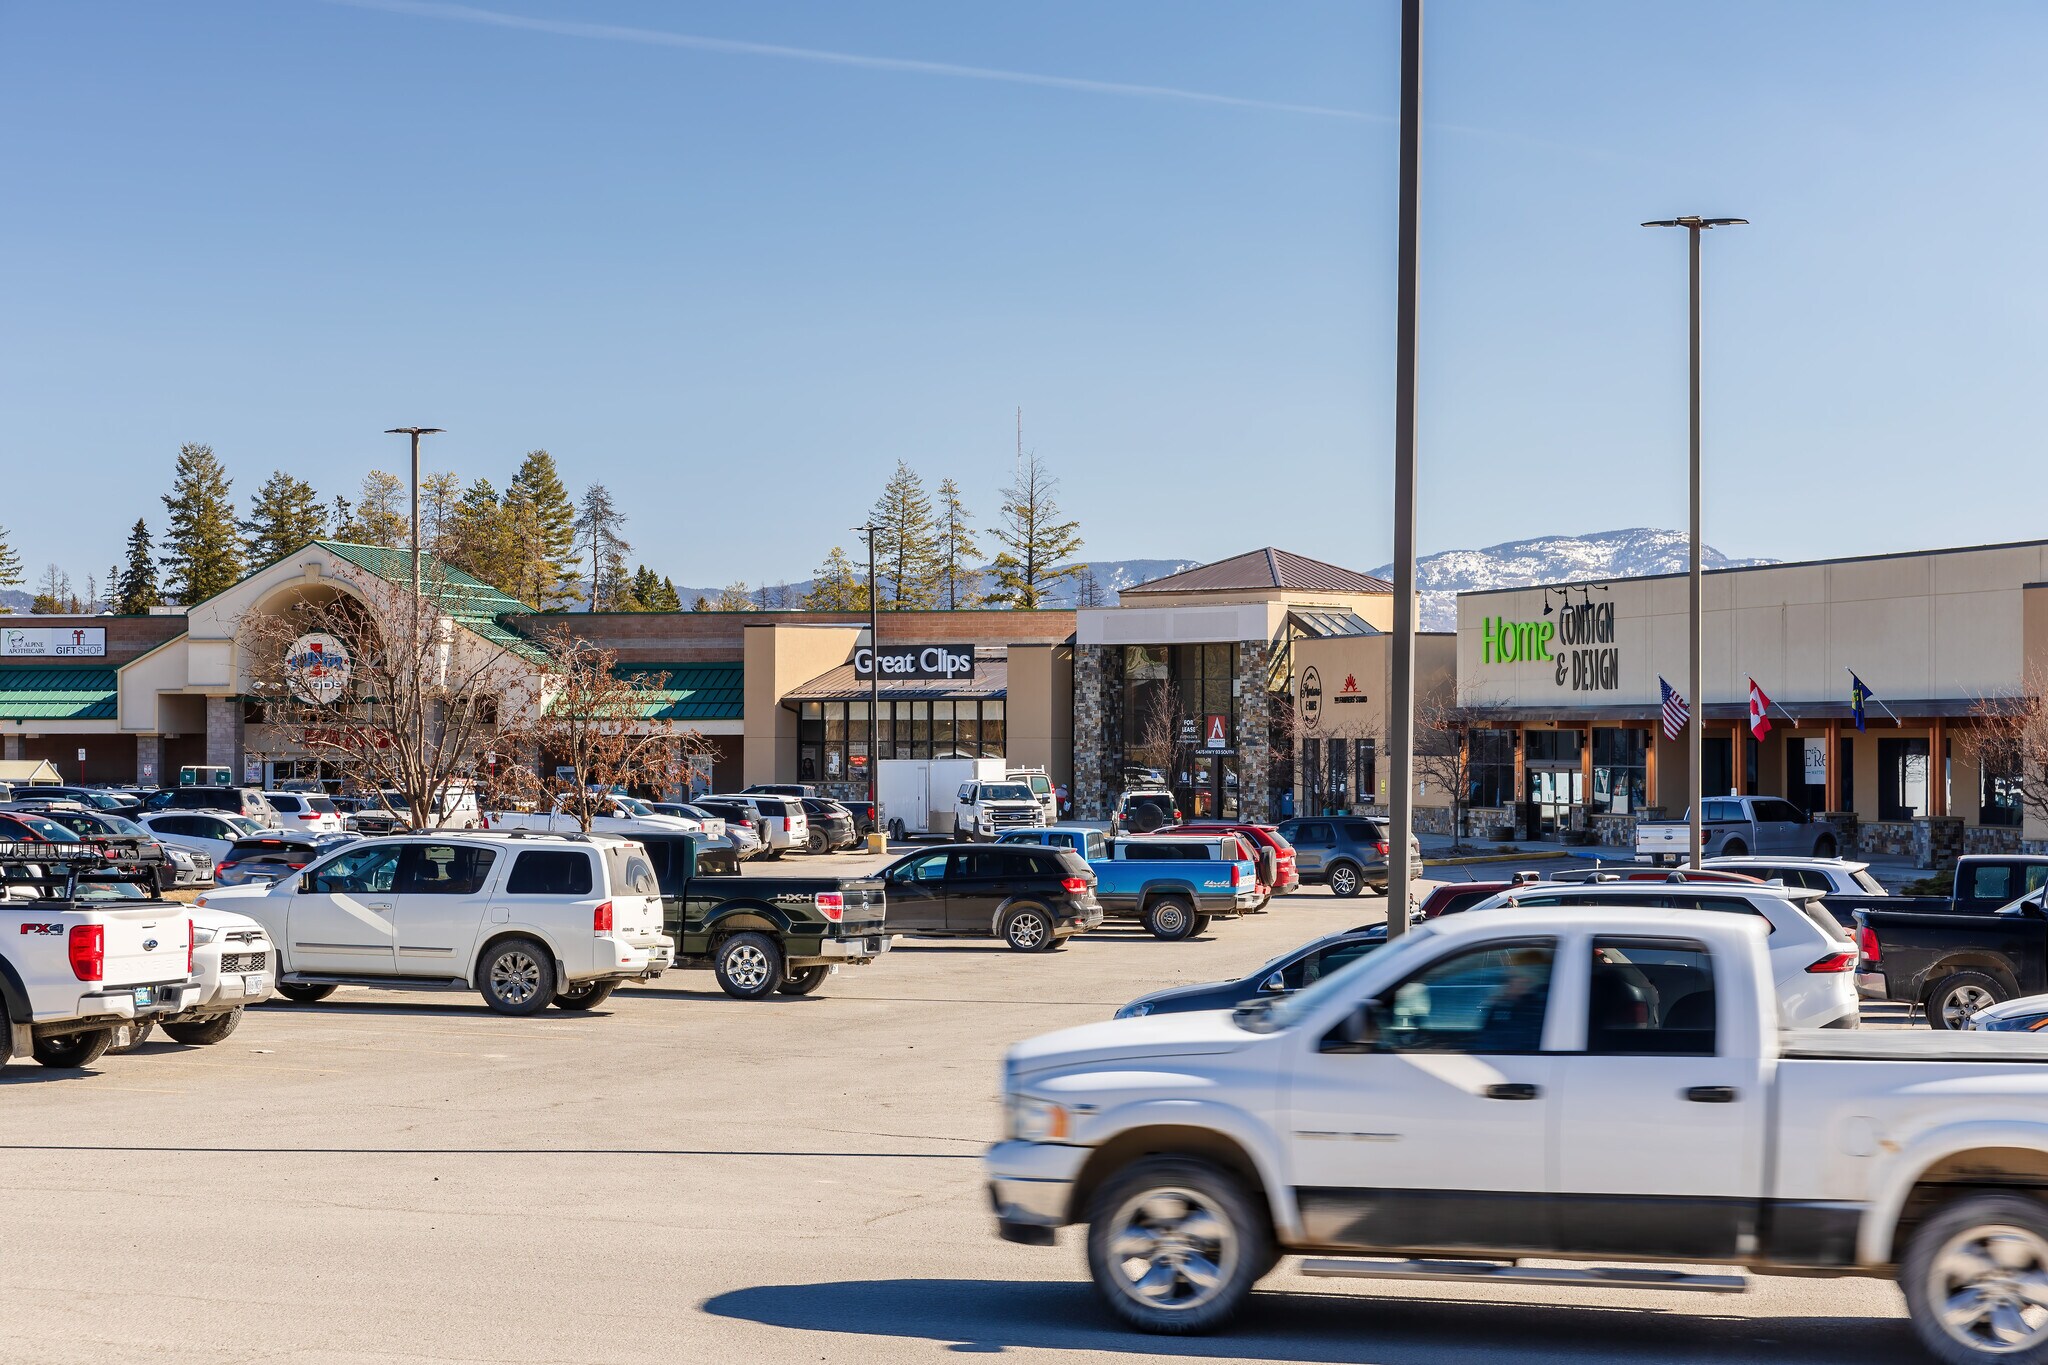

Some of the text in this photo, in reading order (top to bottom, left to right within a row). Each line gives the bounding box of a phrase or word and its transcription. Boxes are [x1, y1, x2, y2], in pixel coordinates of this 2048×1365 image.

[1482, 616, 1554, 664] Home
[1559, 602, 1614, 645] CONSIGN
[855, 647, 971, 679] Great Clips
[1555, 648, 1618, 691] & DESIGN
[20, 923, 64, 934] FX4
